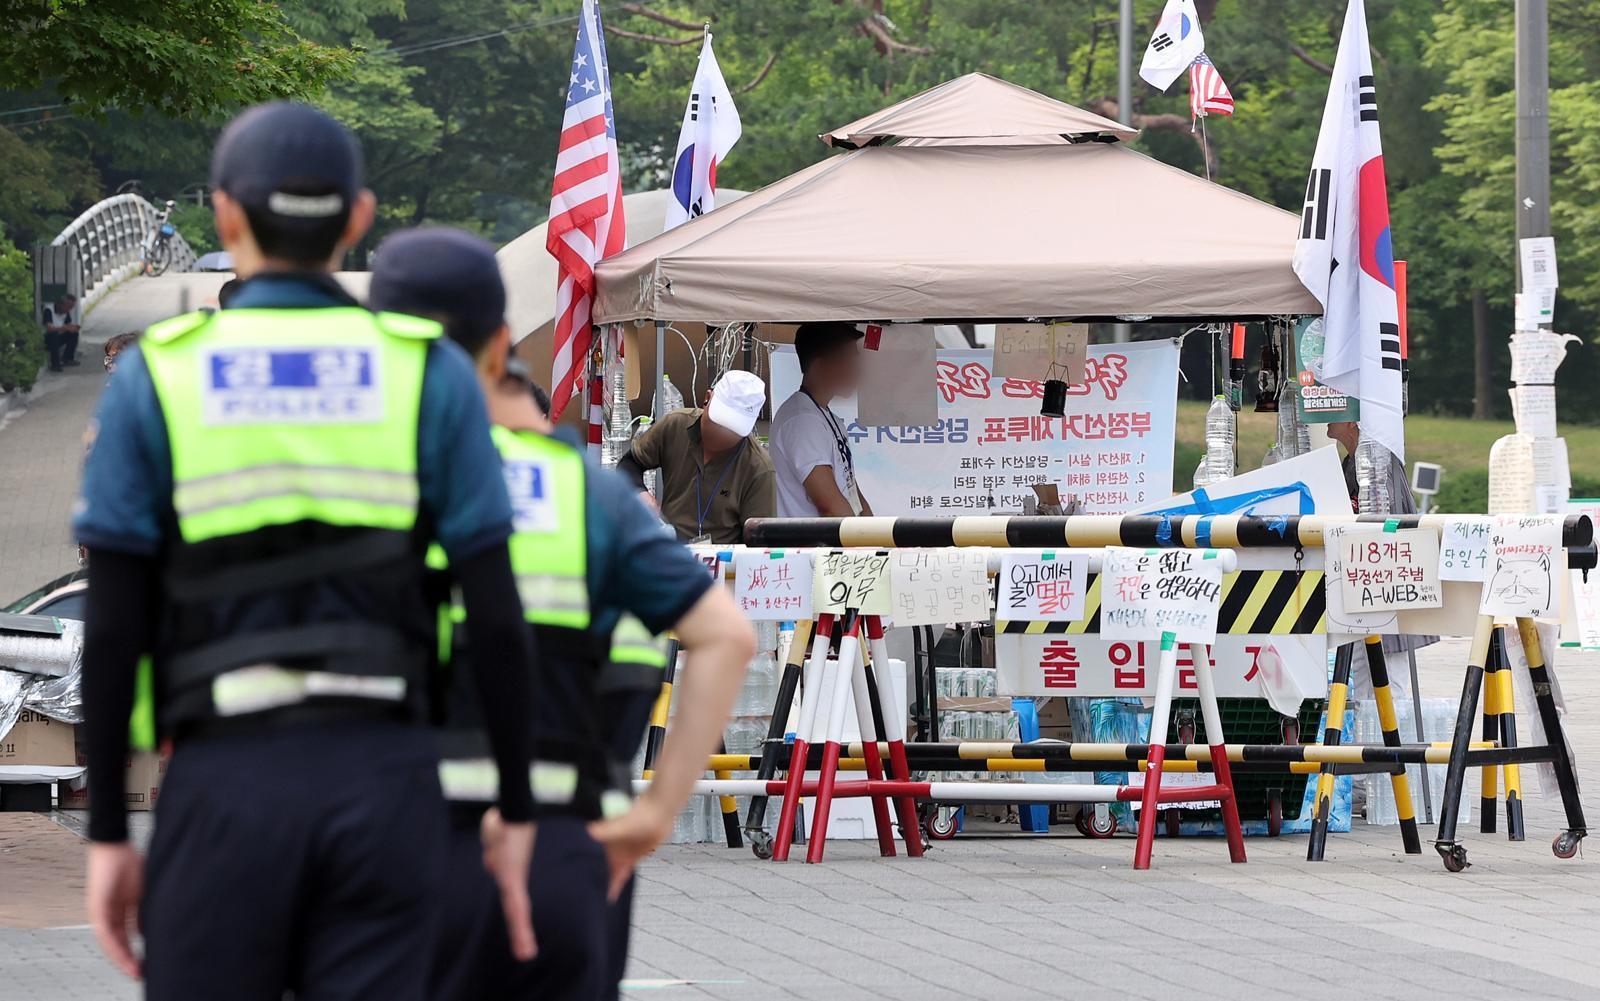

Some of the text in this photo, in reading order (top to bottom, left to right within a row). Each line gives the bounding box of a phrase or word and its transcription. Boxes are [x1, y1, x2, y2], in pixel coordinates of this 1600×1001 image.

[222, 397, 360, 416] POLICE
[1350, 542, 1412, 564] 118개국
[1010, 561, 1072, 607] 올공에서
[1115, 575, 1220, 602] 국민은 영원하다
[1347, 566, 1424, 587] 부정선거 주범
[827, 577, 876, 609] 의무
[1037, 580, 1074, 614] 멸공
[1361, 584, 1418, 606] A-WEB
